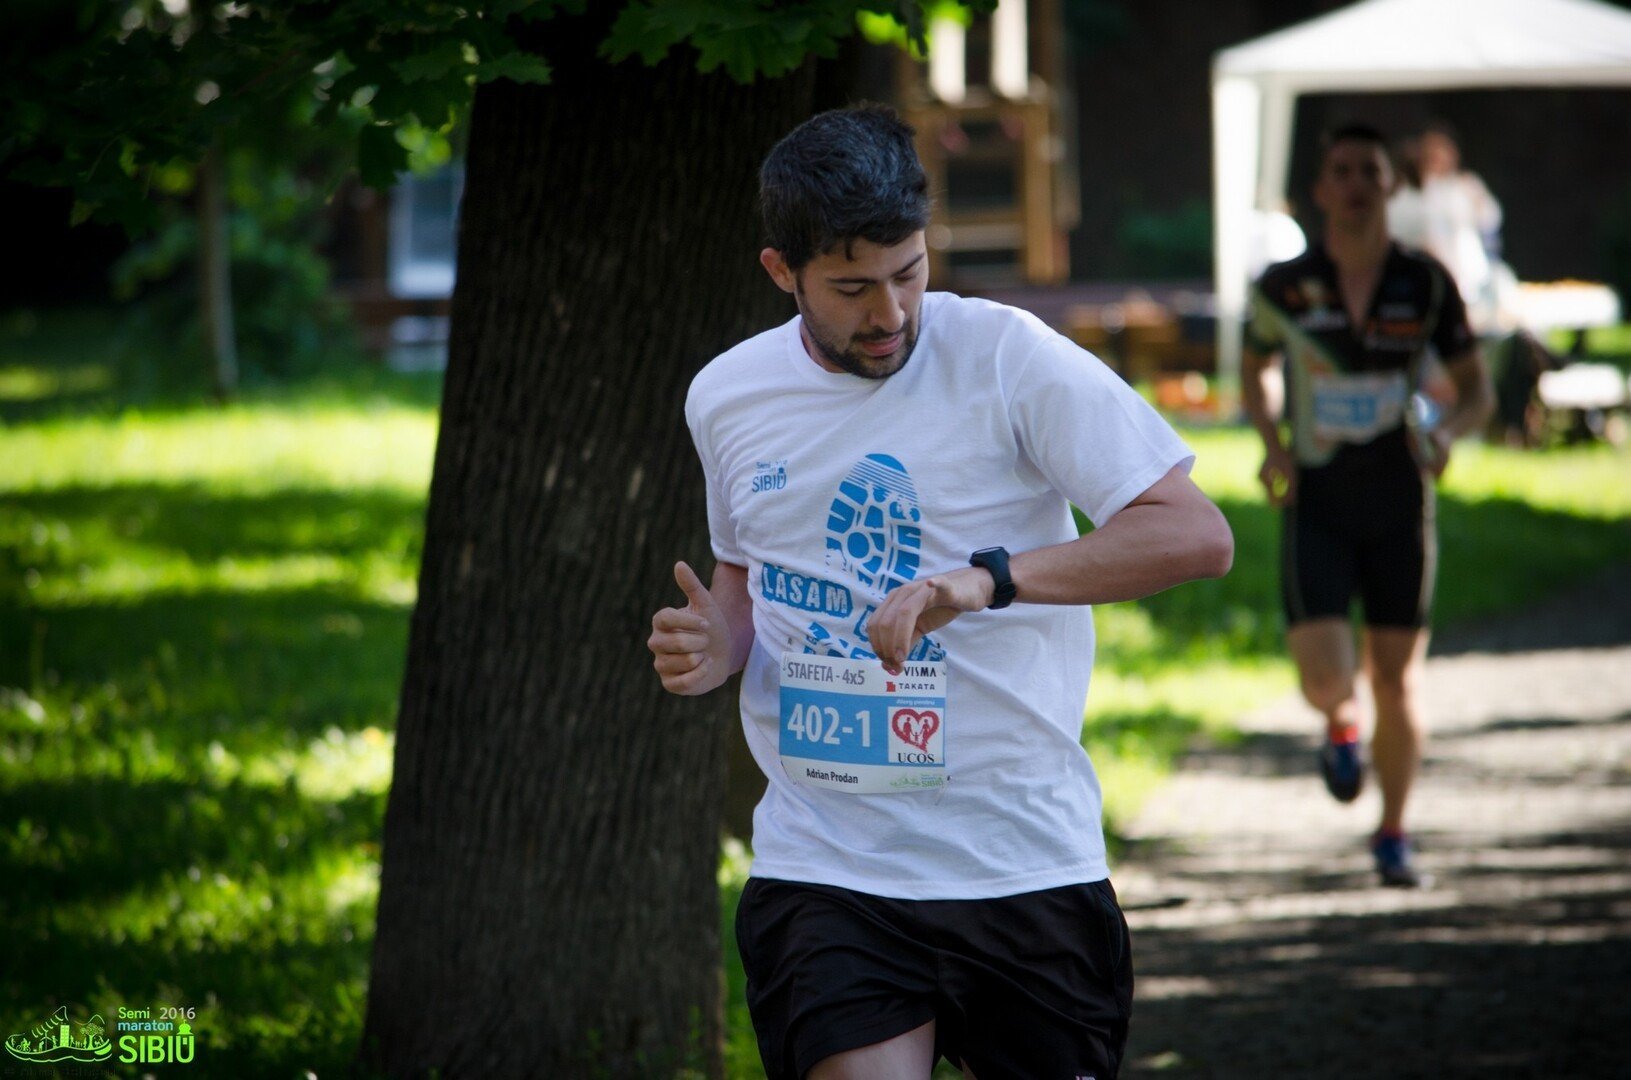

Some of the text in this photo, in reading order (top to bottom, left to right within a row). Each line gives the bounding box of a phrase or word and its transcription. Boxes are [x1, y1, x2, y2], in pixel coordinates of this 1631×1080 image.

[787, 661, 833, 682] STAFETA
[842, 669, 865, 686] 4x5
[904, 667, 937, 678] VISMA
[787, 703, 871, 747] 402-1
[898, 753, 935, 764] UCOS
[806, 768, 858, 784] Adrian Prodan
